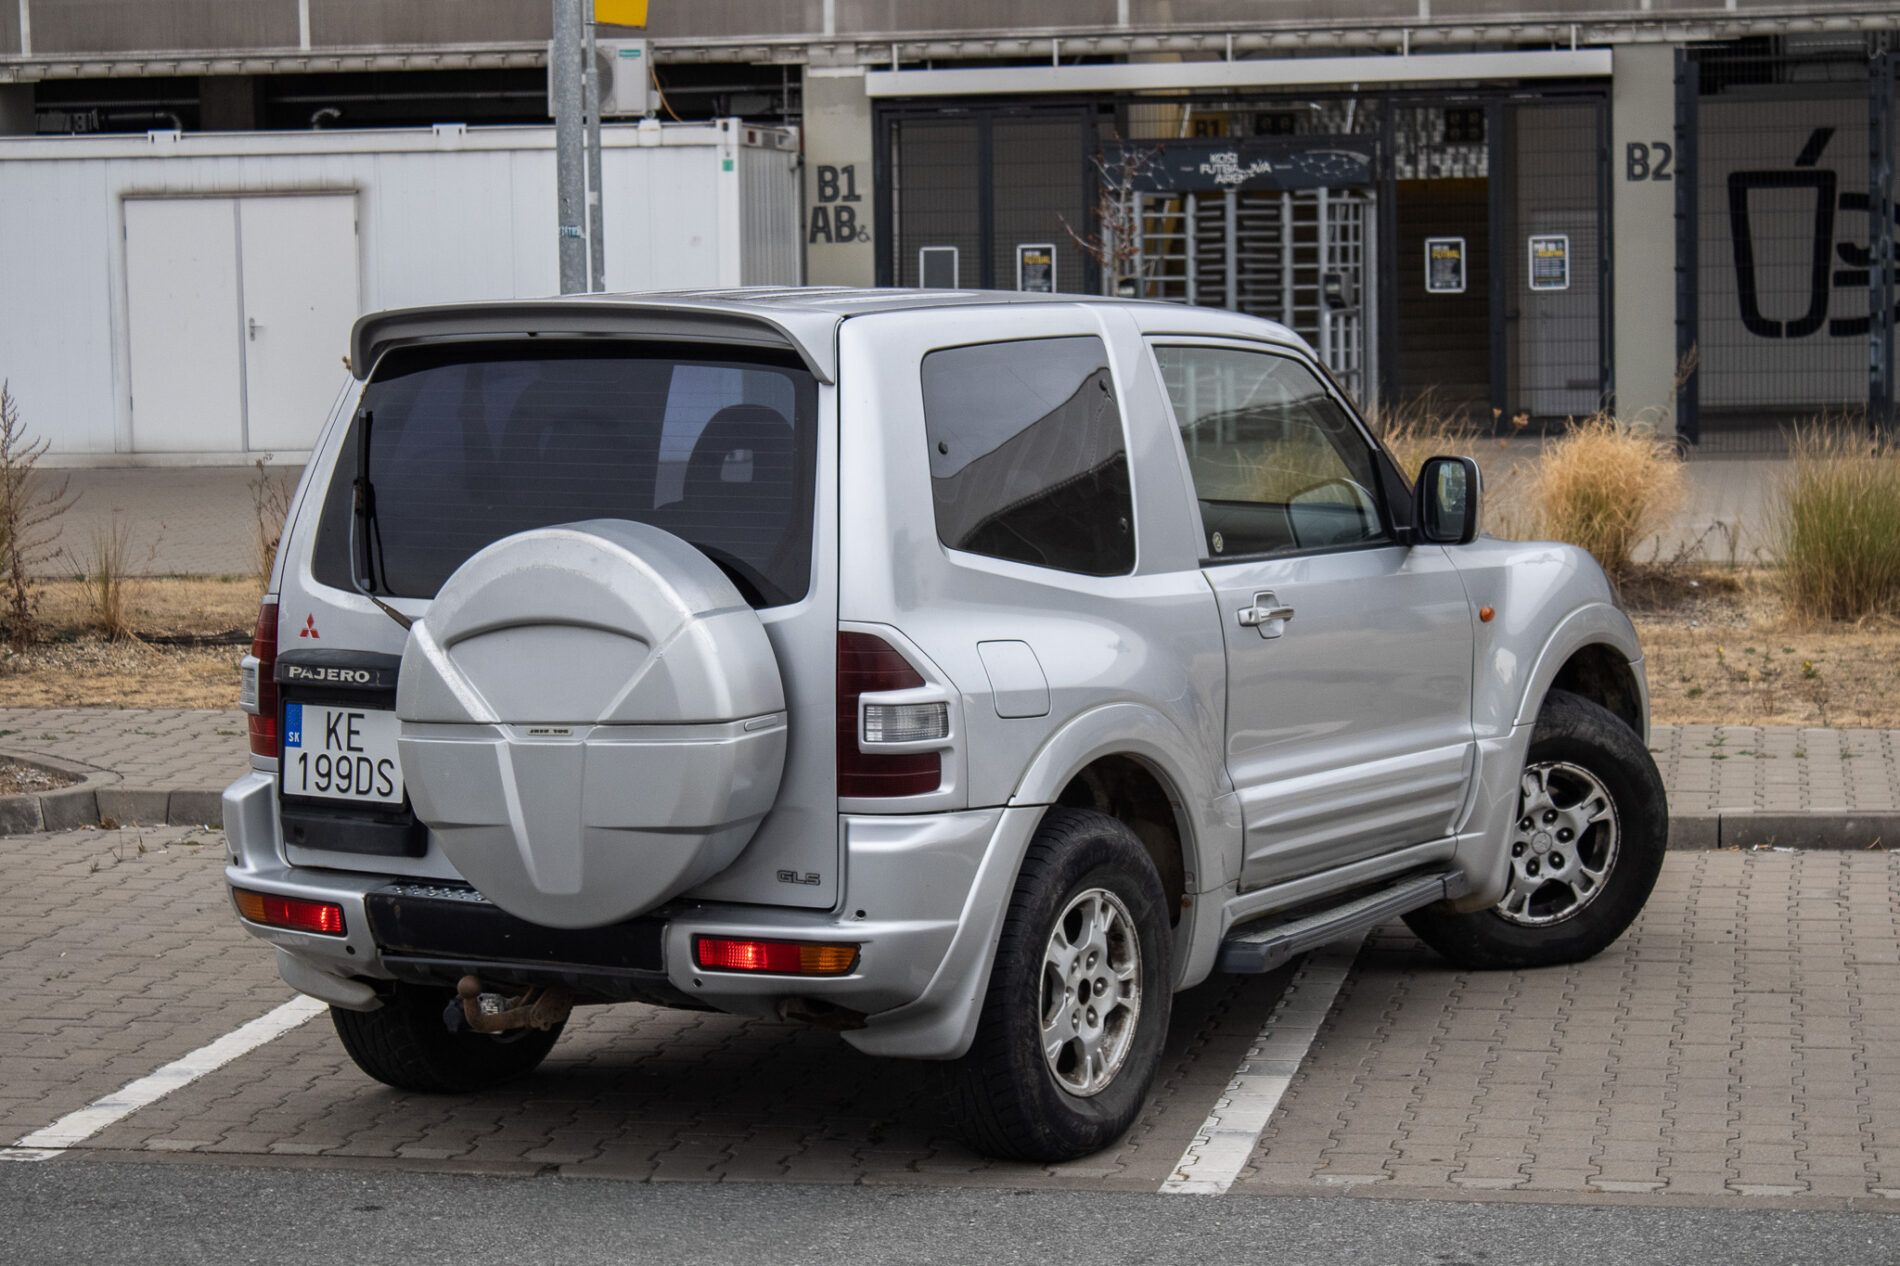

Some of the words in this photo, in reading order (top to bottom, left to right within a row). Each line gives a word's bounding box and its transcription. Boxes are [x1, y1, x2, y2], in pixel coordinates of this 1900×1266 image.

[1626, 142, 1673, 182] B2
[817, 165, 861, 203] B1
[808, 206, 857, 244] AB
[288, 665, 370, 683] PAJERO
[288, 731, 300, 743] SK
[325, 711, 365, 752] KE
[298, 752, 395, 797] 199DS
[776, 869, 821, 886] GLS
